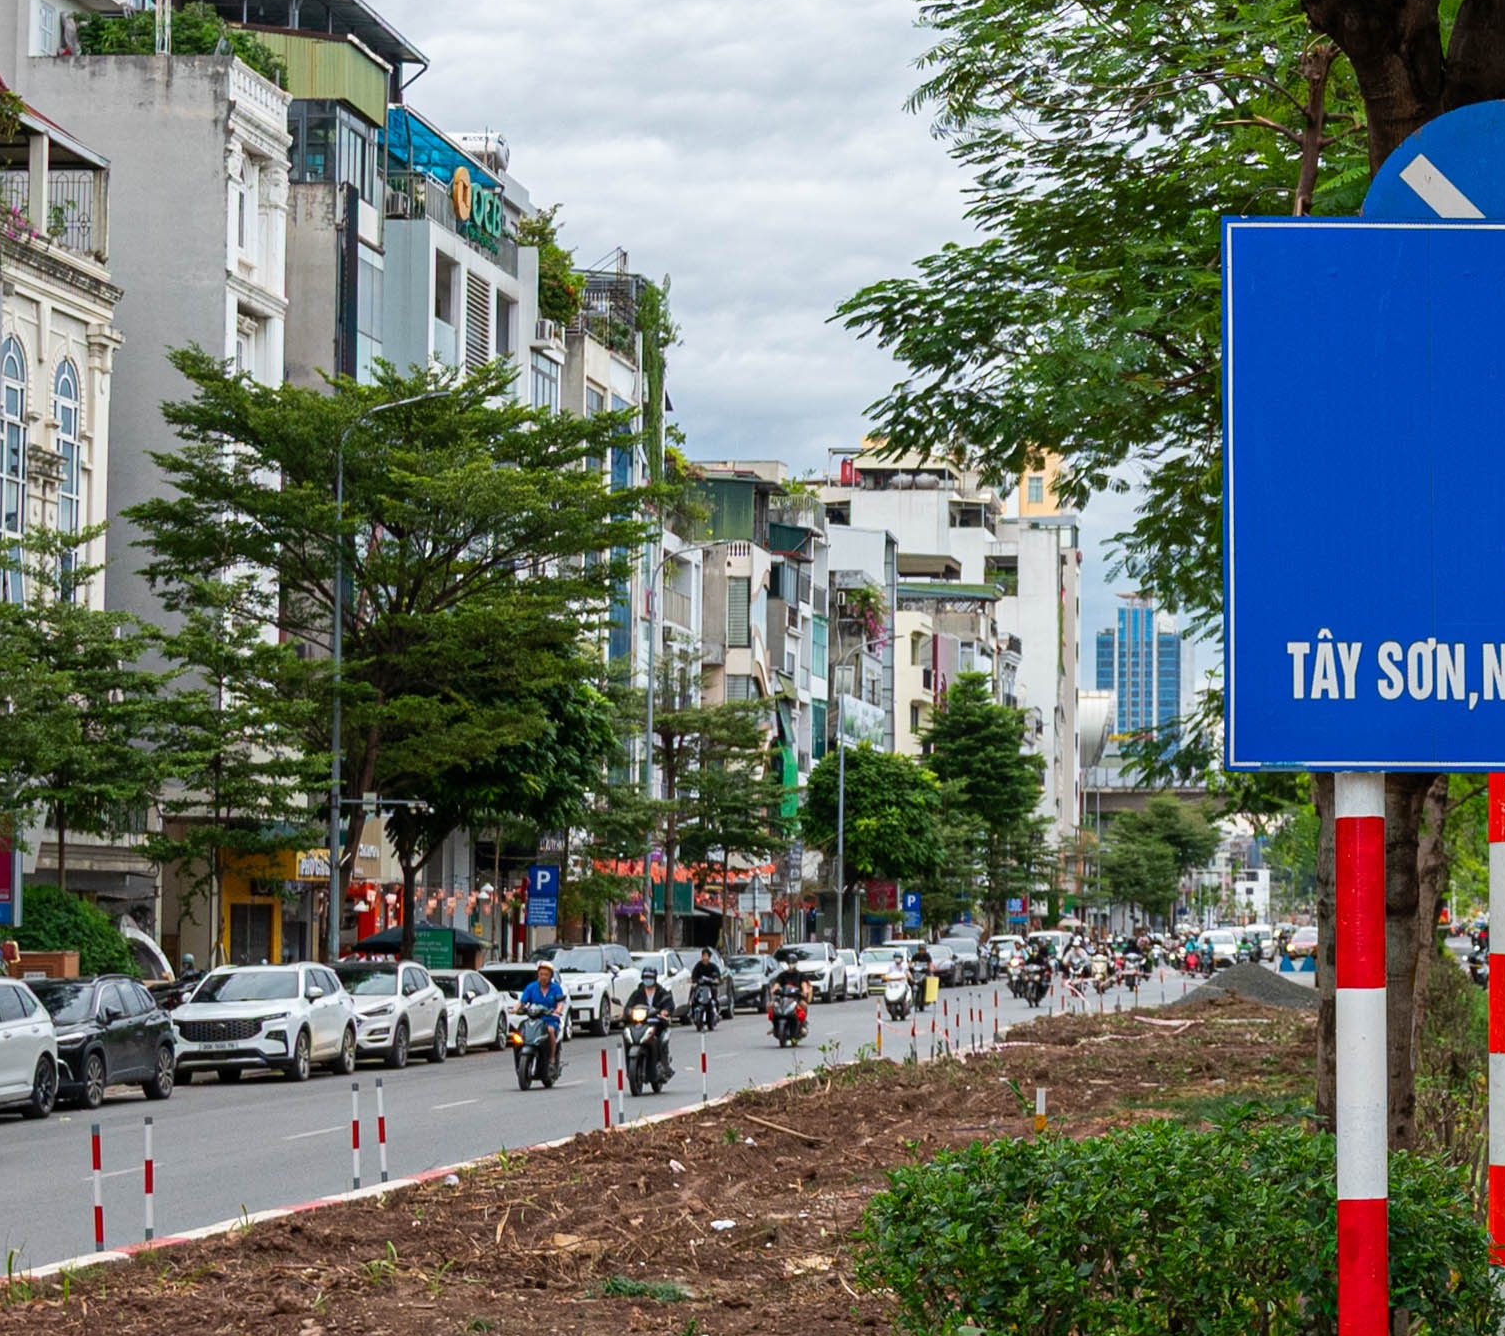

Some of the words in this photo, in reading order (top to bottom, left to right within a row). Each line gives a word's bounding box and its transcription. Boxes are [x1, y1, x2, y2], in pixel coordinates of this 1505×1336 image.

[471, 182, 502, 238] OCB
[1287, 628, 1362, 699] TÂY
[536, 870, 551, 890] P
[907, 894, 916, 907] P
